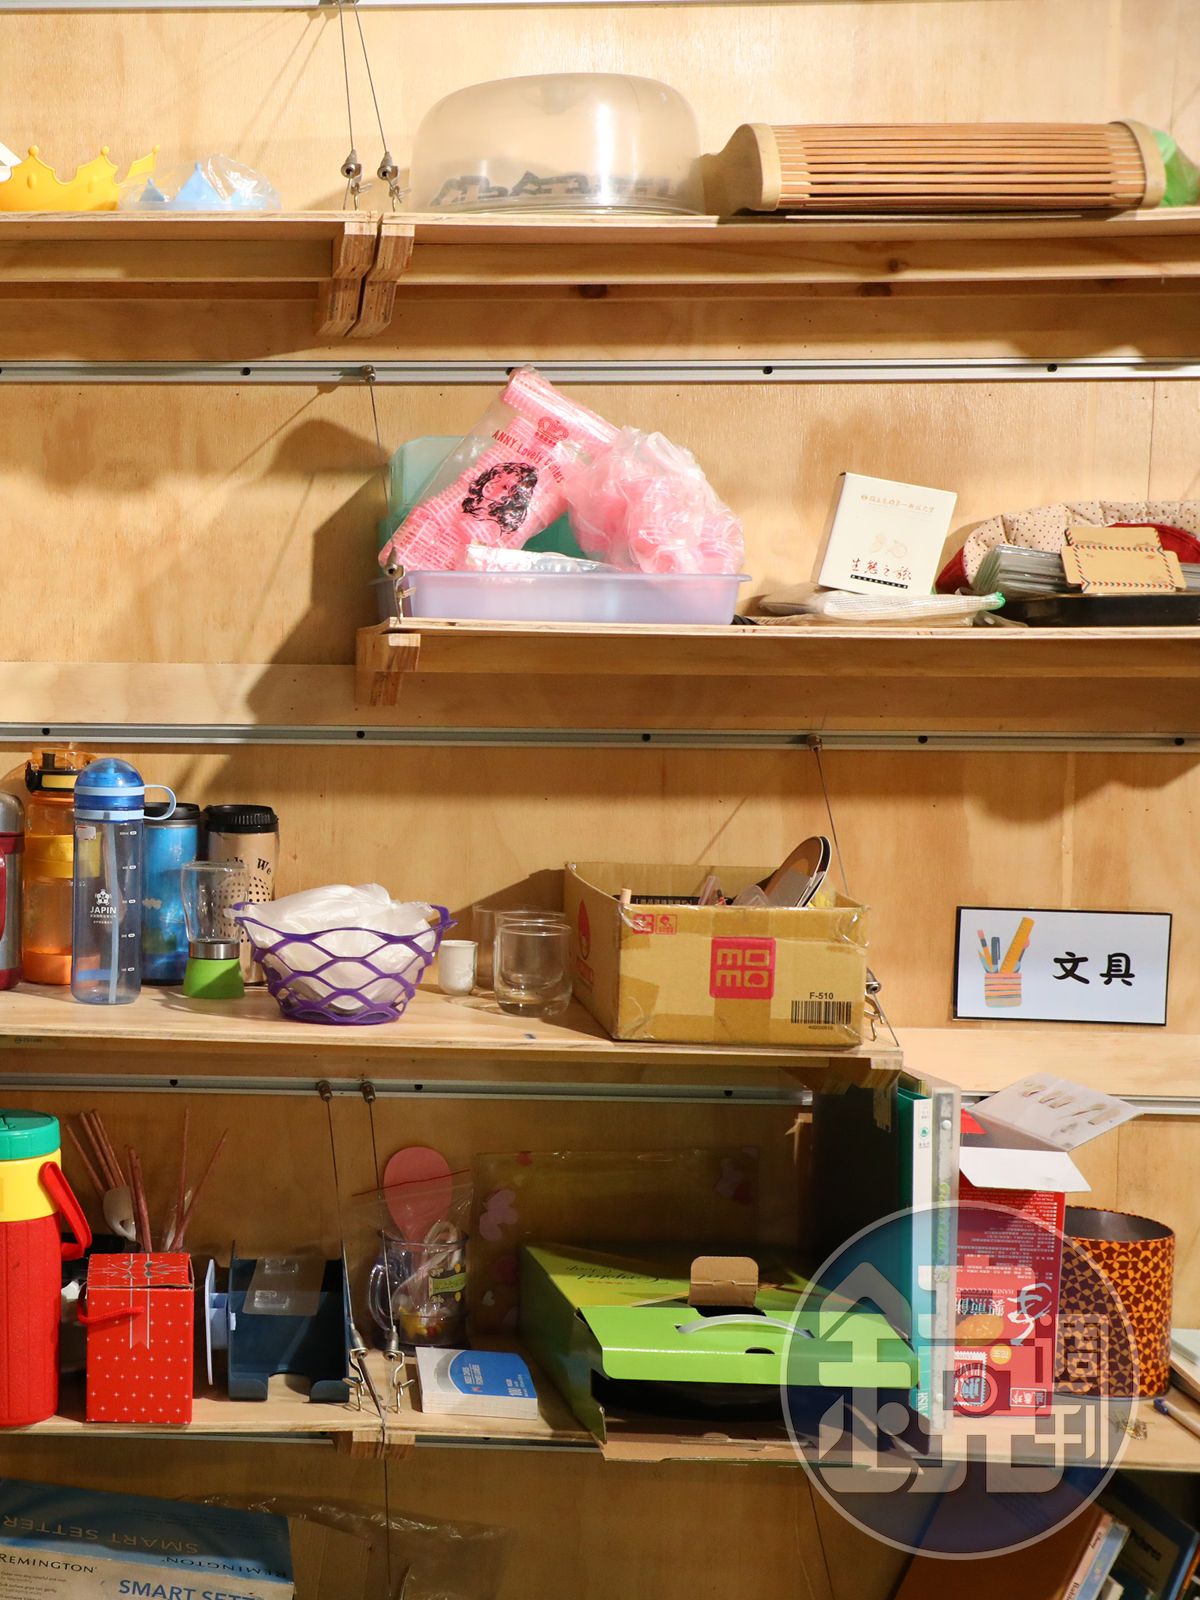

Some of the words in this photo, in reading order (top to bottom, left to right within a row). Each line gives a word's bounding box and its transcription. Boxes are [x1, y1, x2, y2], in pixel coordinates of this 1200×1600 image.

[492, 429, 517, 449] ANNY
[90, 905, 117, 914] JAPIN
[1052, 951, 1135, 987] 文具
[809, 991, 834, 1000] F-510
[3, 1515, 99, 1541] SETTER
[106, 1532, 199, 1554] SMART
[119, 1579, 196, 1600] SMART
